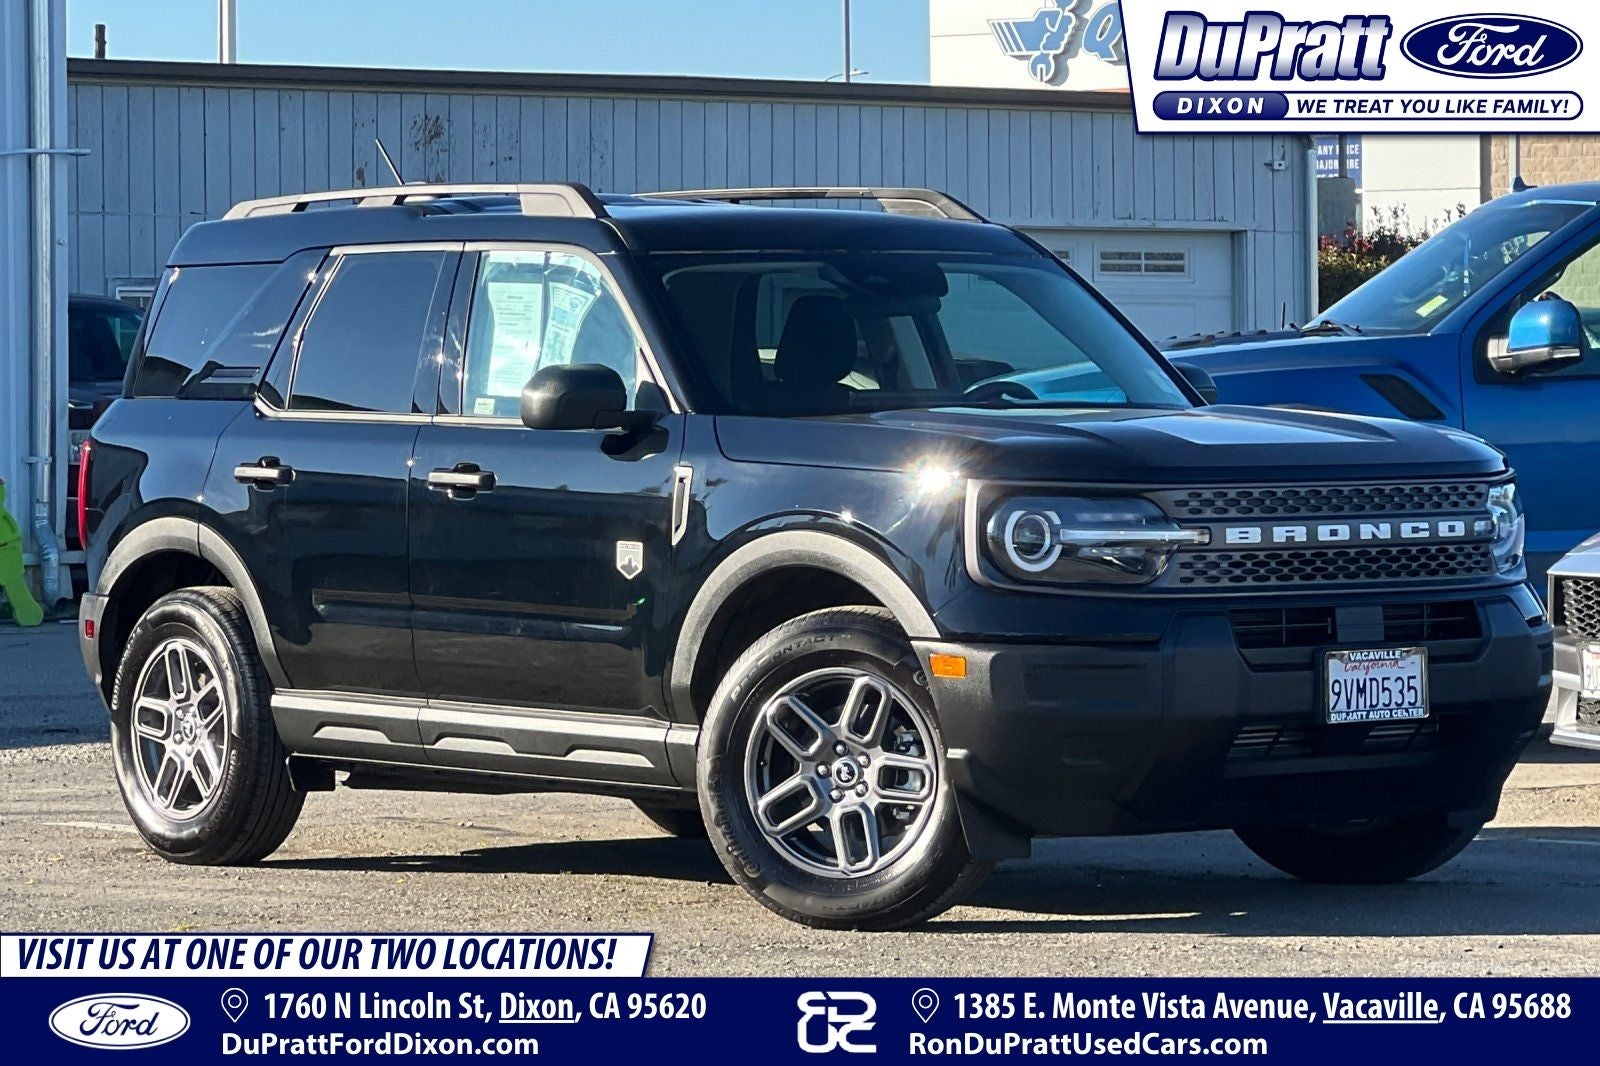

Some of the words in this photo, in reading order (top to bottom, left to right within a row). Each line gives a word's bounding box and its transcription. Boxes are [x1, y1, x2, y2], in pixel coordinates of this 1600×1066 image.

[1317, 144, 1334, 155] ANY
[1225, 520, 1465, 544] BRONCO
[1349, 650, 1402, 661] VACAVILLE
[1344, 660, 1407, 676] California
[1331, 675, 1418, 711] 9VMD535
[1368, 710, 1391, 720] AUTO
[1392, 708, 1424, 718] CENTER
